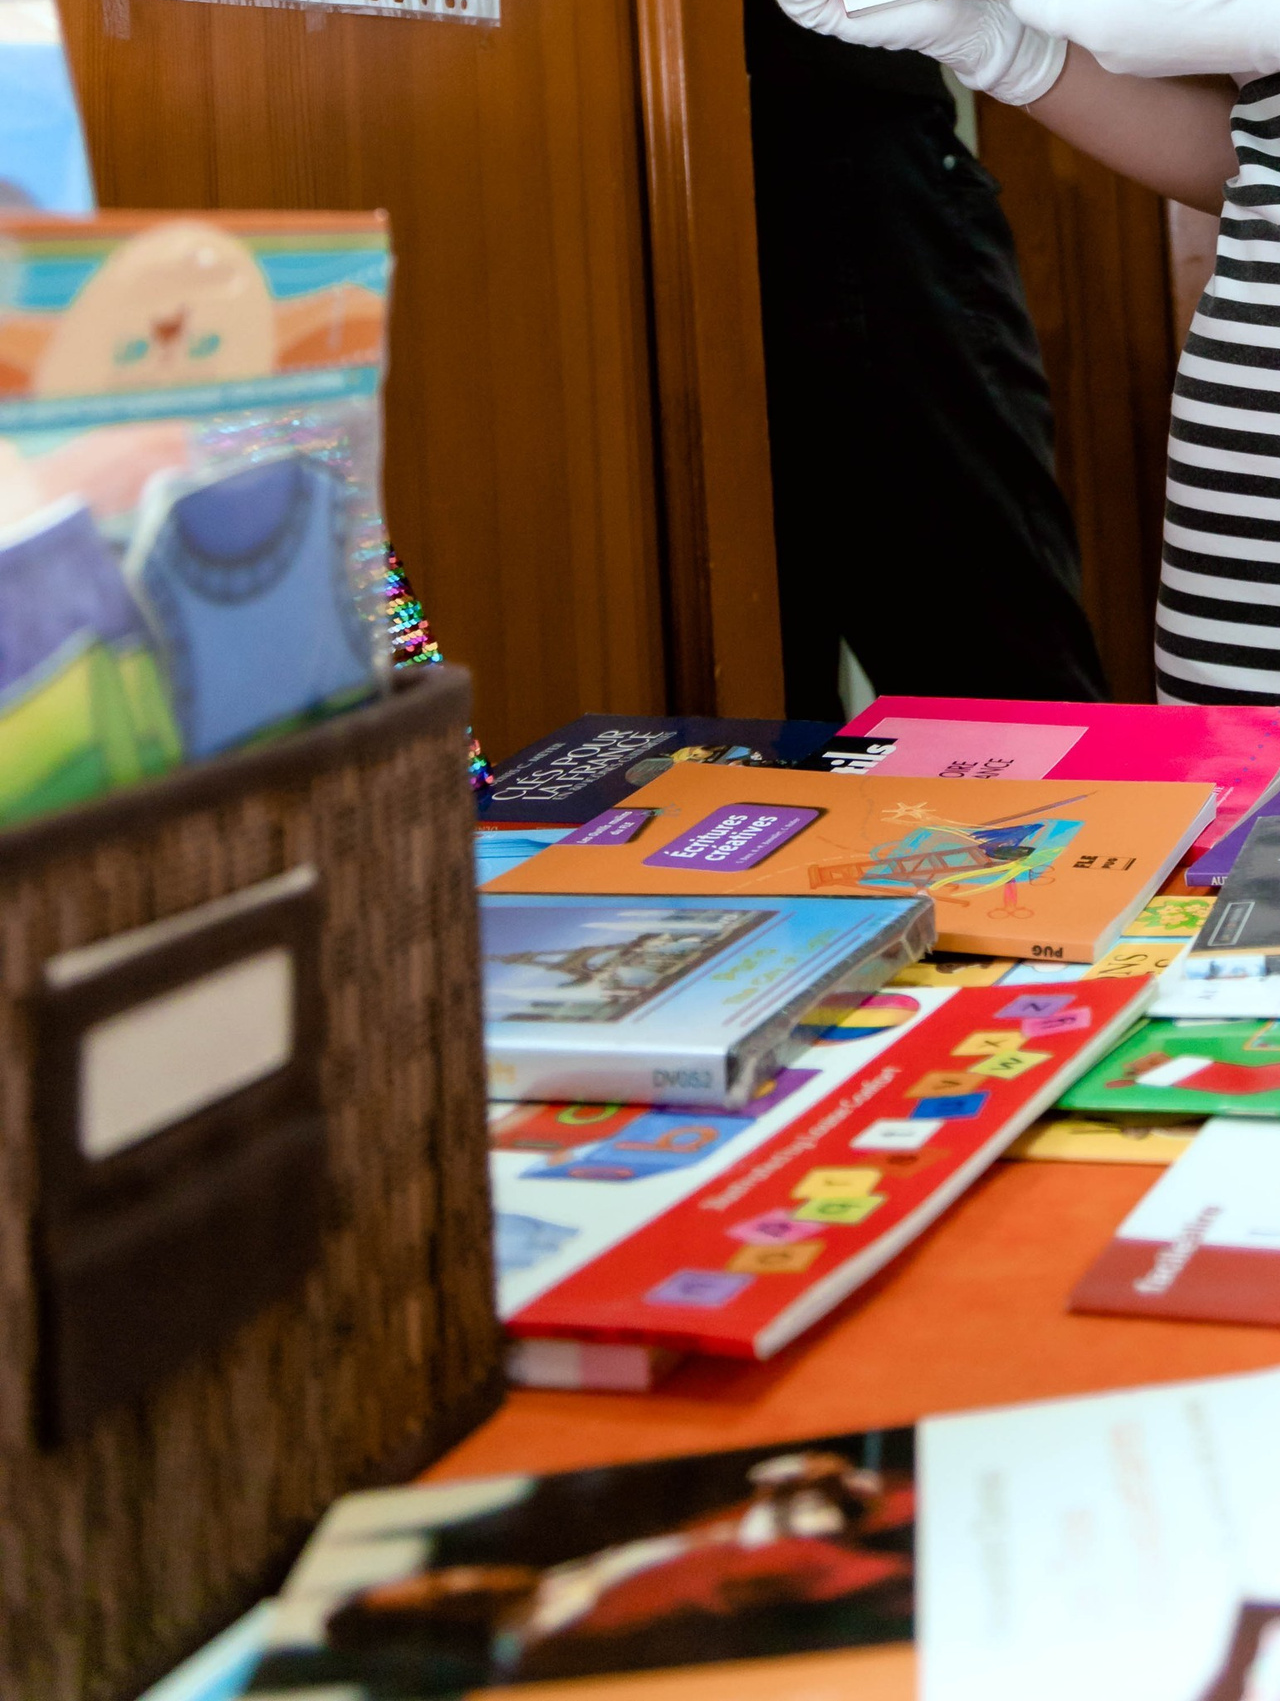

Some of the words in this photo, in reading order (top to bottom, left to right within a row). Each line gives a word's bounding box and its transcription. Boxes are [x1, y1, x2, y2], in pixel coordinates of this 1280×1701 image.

[491, 768, 558, 800] CLÉS
[550, 729, 634, 767] POUR
[522, 782, 573, 800] LA
[558, 731, 665, 781] FRANCE
[664, 813, 749, 861] Écritures
[703, 814, 779, 862] créatives
[1073, 854, 1099, 869] FLE
[1031, 944, 1064, 959] PUG
